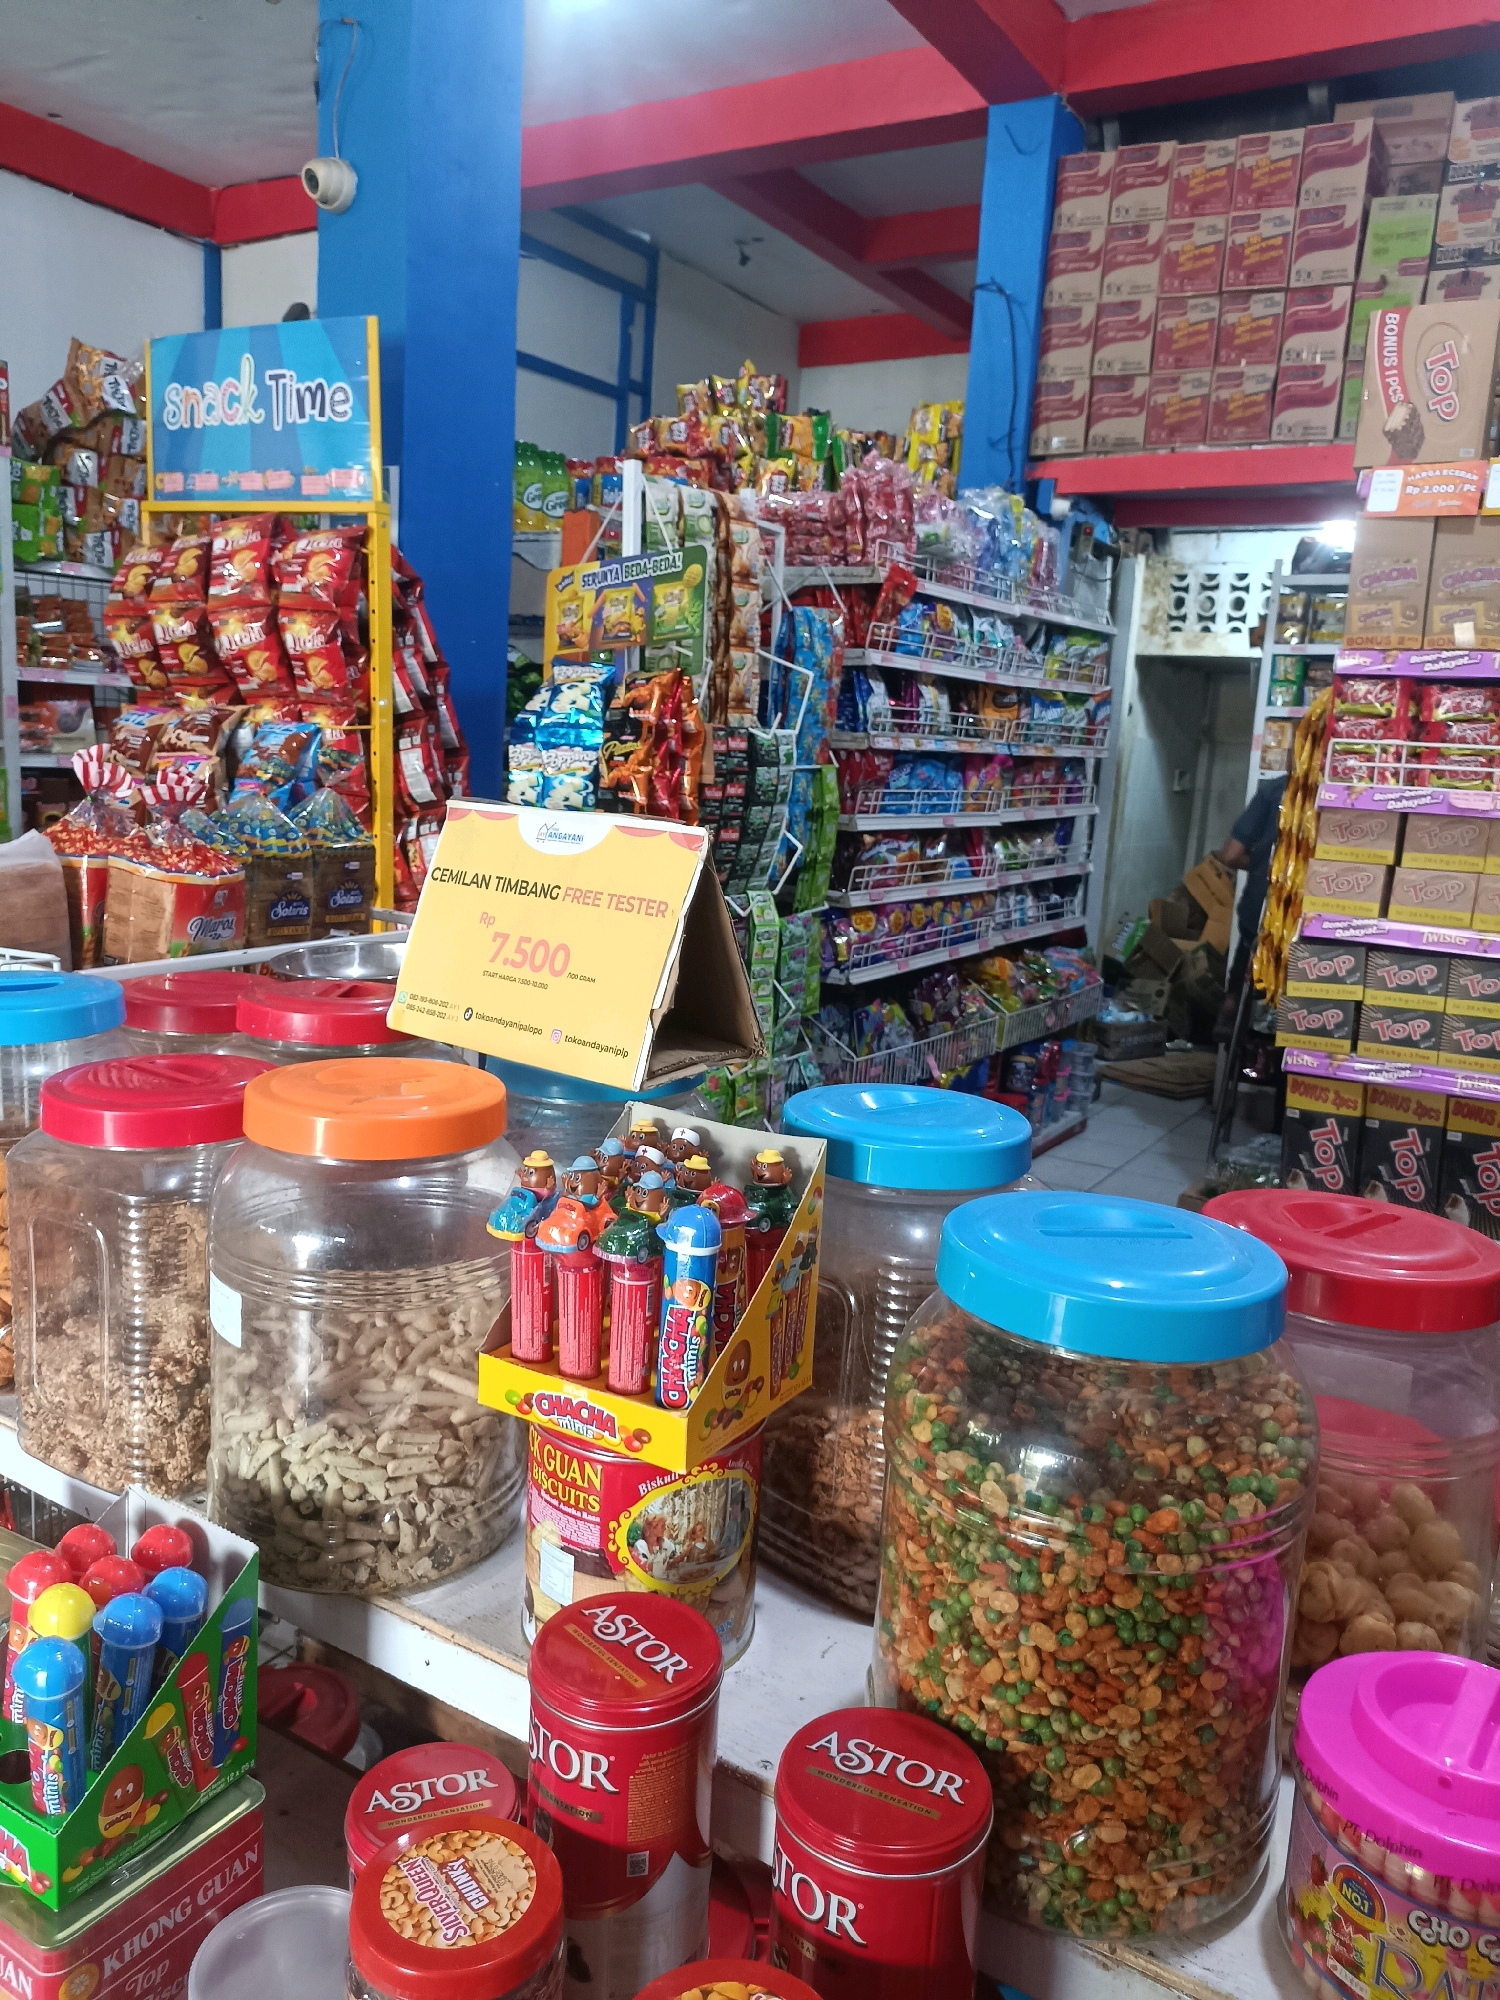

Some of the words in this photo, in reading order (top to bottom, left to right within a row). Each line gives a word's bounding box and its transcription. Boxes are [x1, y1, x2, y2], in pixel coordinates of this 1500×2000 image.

[1383, 312, 1400, 368] BONUS
[164, 354, 265, 430] snack
[266, 370, 352, 430] Time
[1405, 485, 1420, 495] Rp
[1427, 637, 1456, 647] BON
[430, 866, 491, 890] CEMILAN
[494, 875, 562, 901] TIMBANG
[562, 886, 604, 908] FREE
[606, 892, 669, 919] TESTER
[478, 911, 496, 929] Rp
[488, 931, 571, 978] 7.500
[662, 1306, 693, 1409] CHACHA
[687, 1336, 701, 1382] minis
[533, 1393, 617, 1440] CHACHA
[557, 1415, 595, 1440] minis
[533, 1462, 601, 1514] BISCUITS
[543, 1443, 603, 1492] GUAN
[580, 1604, 688, 1685] ASTOR
[806, 1730, 965, 1805] ASTOR
[46, 1772, 62, 1816] minis
[364, 1768, 499, 1815] ASTOR
[387, 1811, 438, 1828] WONDERFUL
[440, 1802, 485, 1817] SENSATION
[817, 1769, 875, 1796] WONDERFUL
[877, 1790, 932, 1816] SENSATION
[1365, 1831, 1423, 1859] Dolphin
[103, 1896, 193, 1980] KHONG
[196, 1841, 260, 1907] GUAN
[1407, 1909, 1471, 1951] CHO
